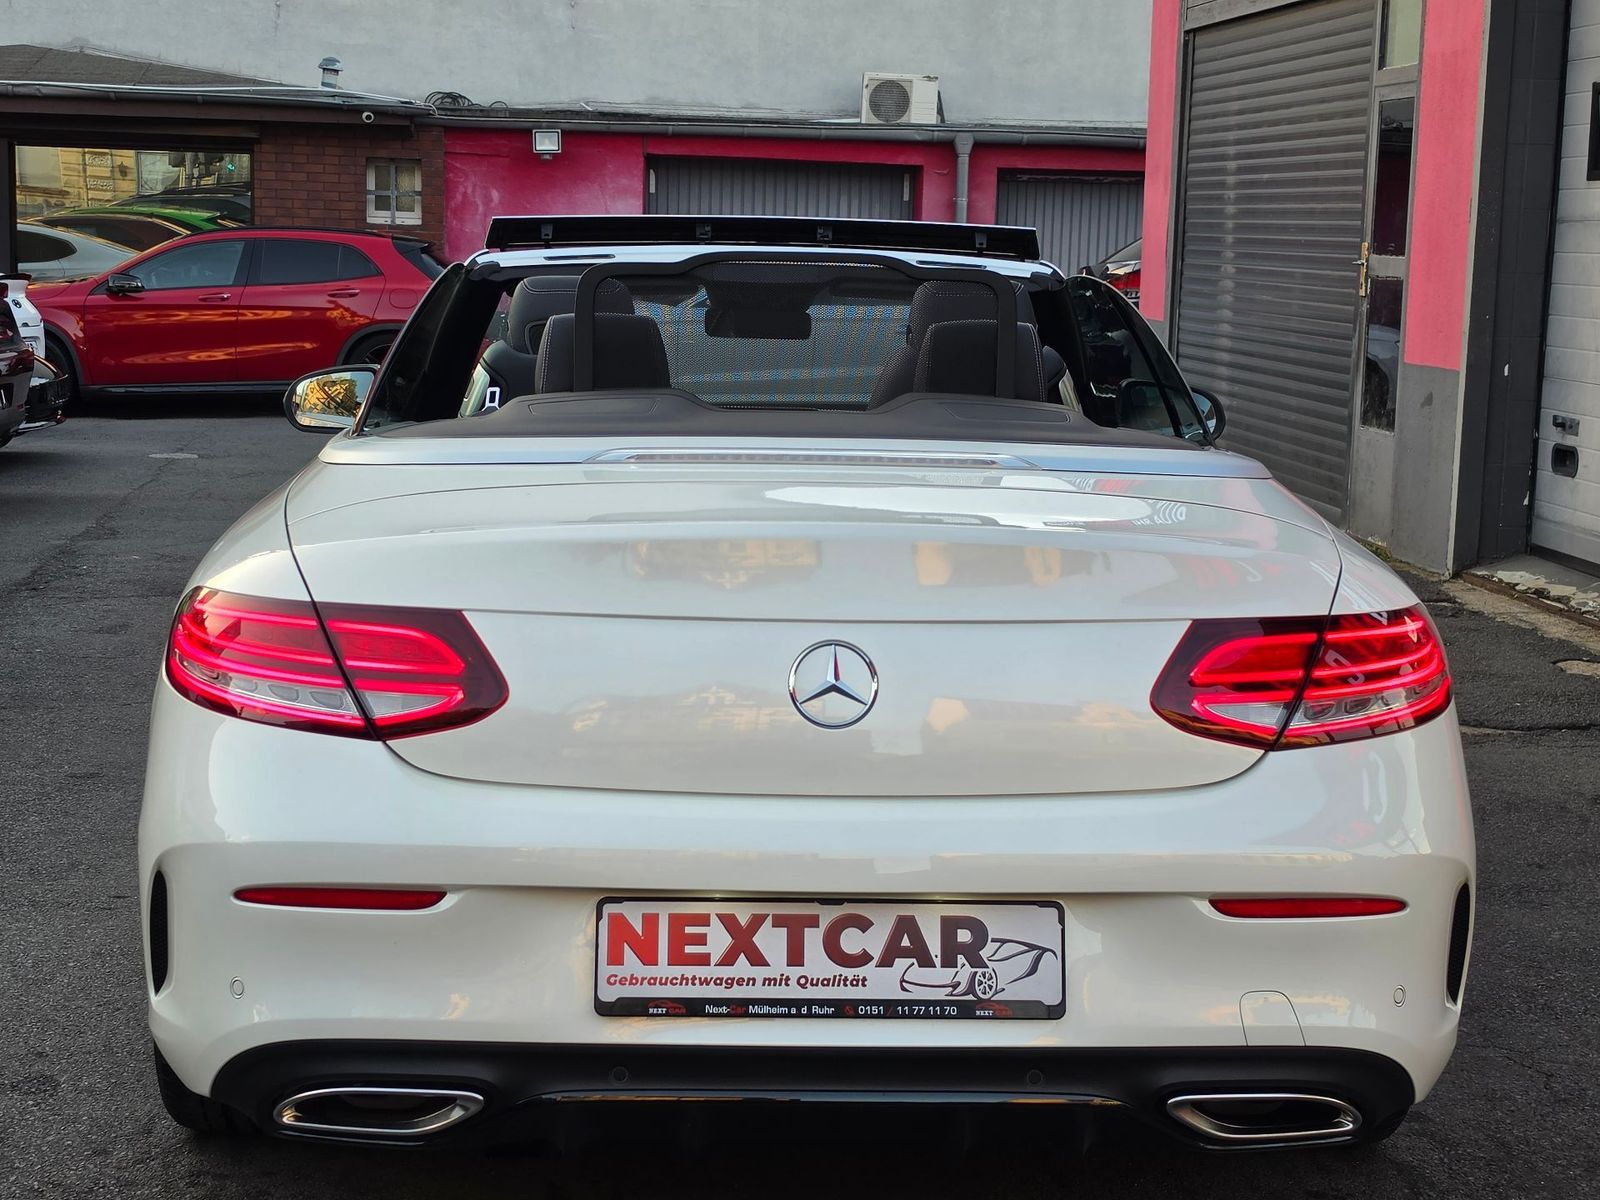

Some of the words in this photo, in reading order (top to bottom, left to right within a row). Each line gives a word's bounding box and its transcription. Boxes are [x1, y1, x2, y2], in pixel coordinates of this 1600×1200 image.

[607, 912, 990, 968] NEXTCAR
[606, 973, 757, 989] Gebrauchtwagen
[761, 974, 791, 987] mit
[796, 974, 868, 989] Qualität
[705, 1005, 747, 1014] Next-Car
[748, 1004, 788, 1014] Mülheim
[811, 1005, 835, 1015] Ruhr
[858, 1005, 884, 1015] 0151
[897, 1006, 909, 1015] 11
[912, 1006, 925, 1015] 77
[928, 1006, 941, 1015] 11
[943, 1006, 957, 1016] 70
